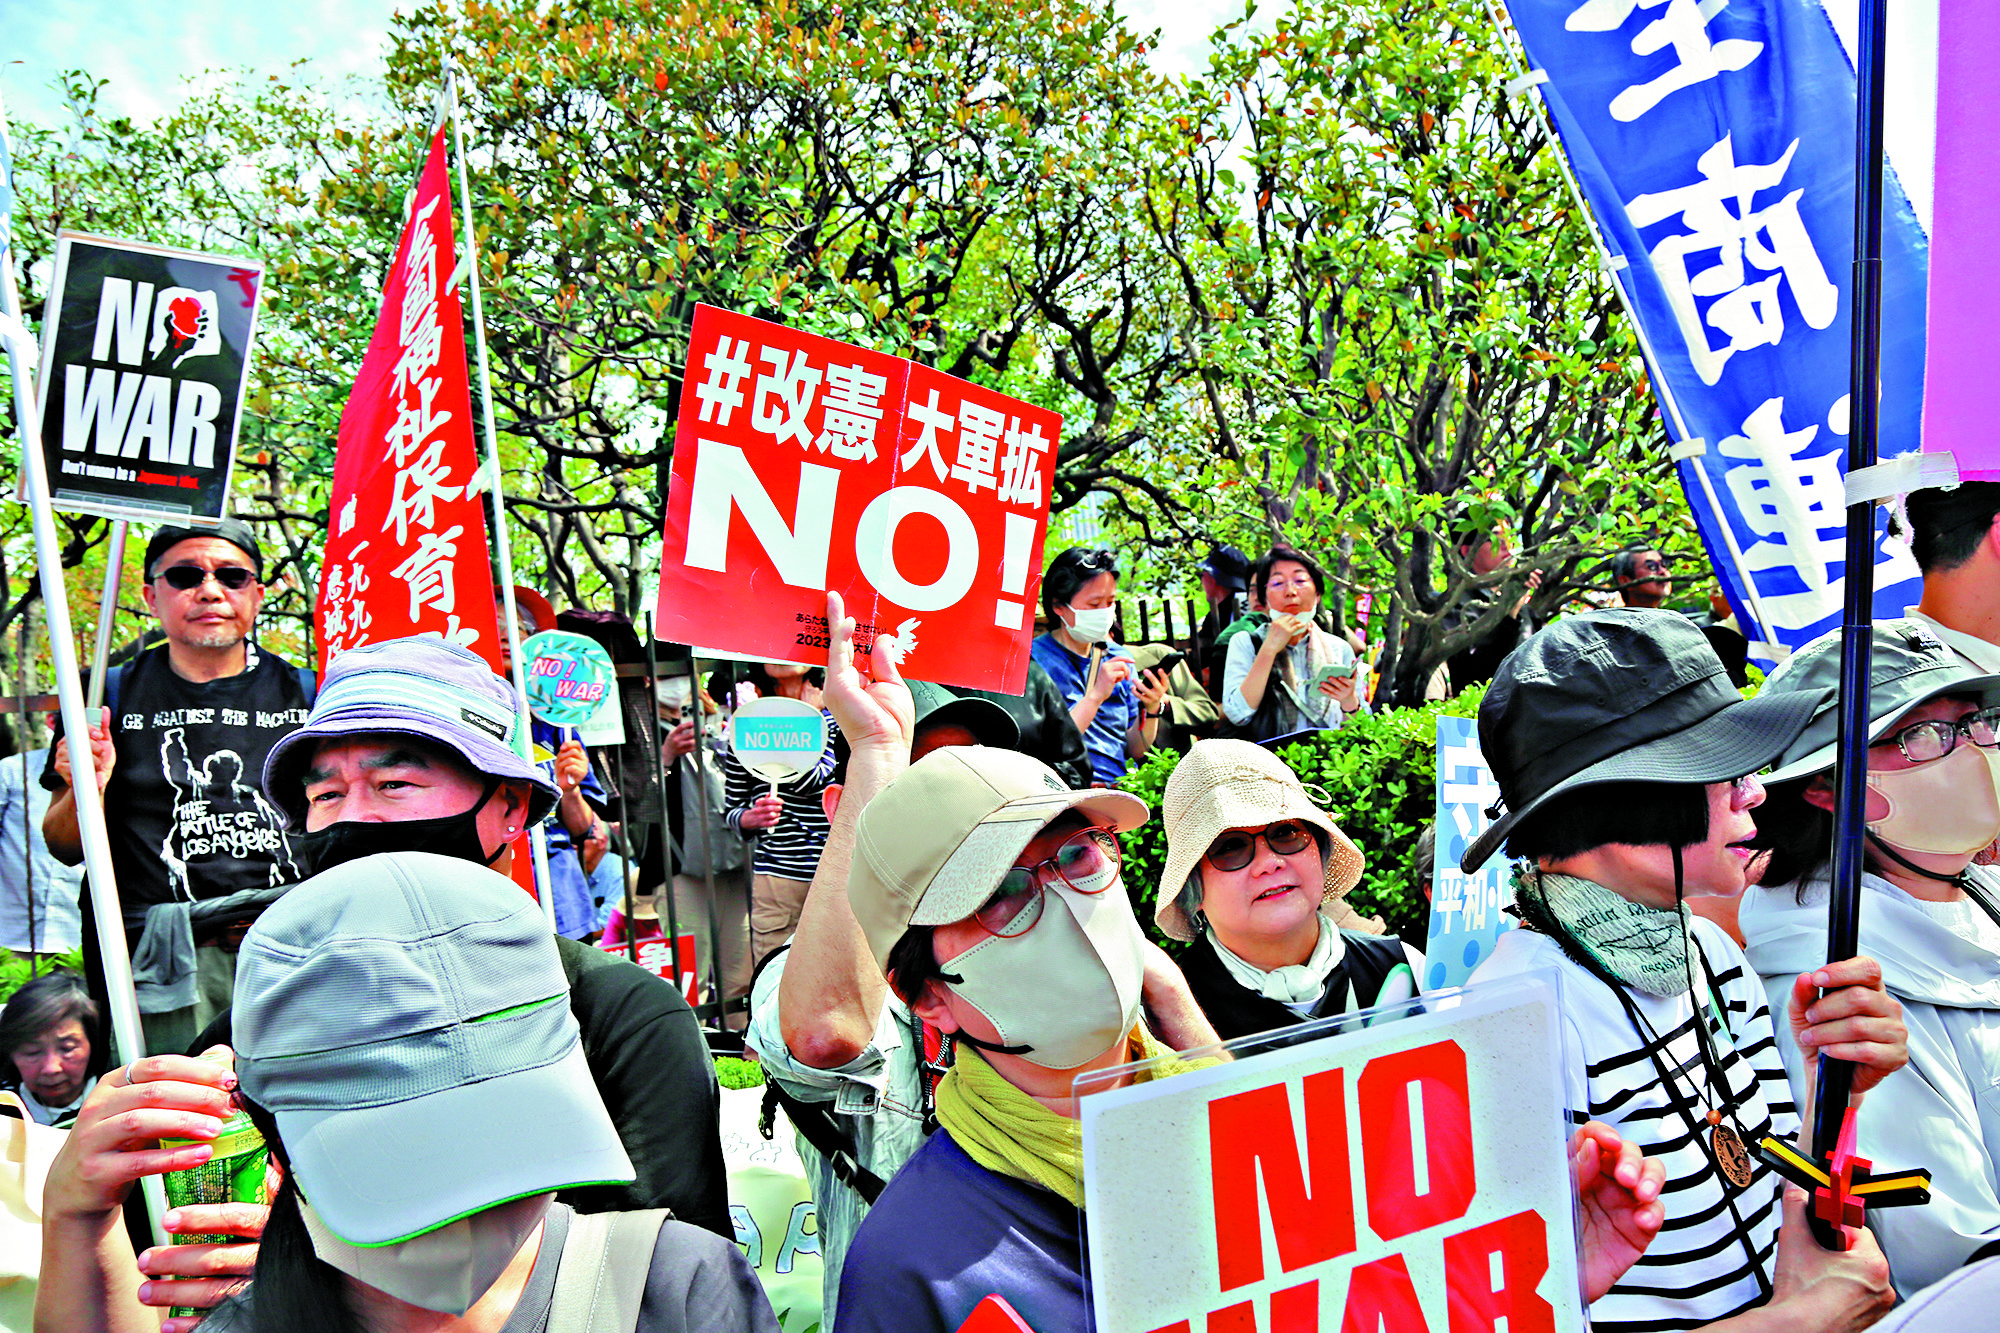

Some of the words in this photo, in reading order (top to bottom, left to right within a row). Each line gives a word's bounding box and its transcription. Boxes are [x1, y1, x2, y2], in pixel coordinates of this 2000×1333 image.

[92, 276, 222, 369] NO
[62, 363, 222, 469] WAR
[696, 335, 888, 464] #改憲
[900, 388, 1051, 510] 大軍拡
[683, 437, 1038, 631] NO!
[796, 634, 831, 649] 2023
[555, 680, 605, 701] WAR
[122, 713, 144, 730] GE
[152, 708, 215, 728] AGAINST
[221, 708, 249, 726] THE
[255, 708, 310, 728] MACHIN
[745, 731, 770, 748] NO
[772, 731, 812, 748] WAR
[180, 800, 212, 820] THE
[180, 813, 235, 838] BATTLE
[234, 811, 259, 829] OF
[1208, 1038, 1477, 1293] NO
